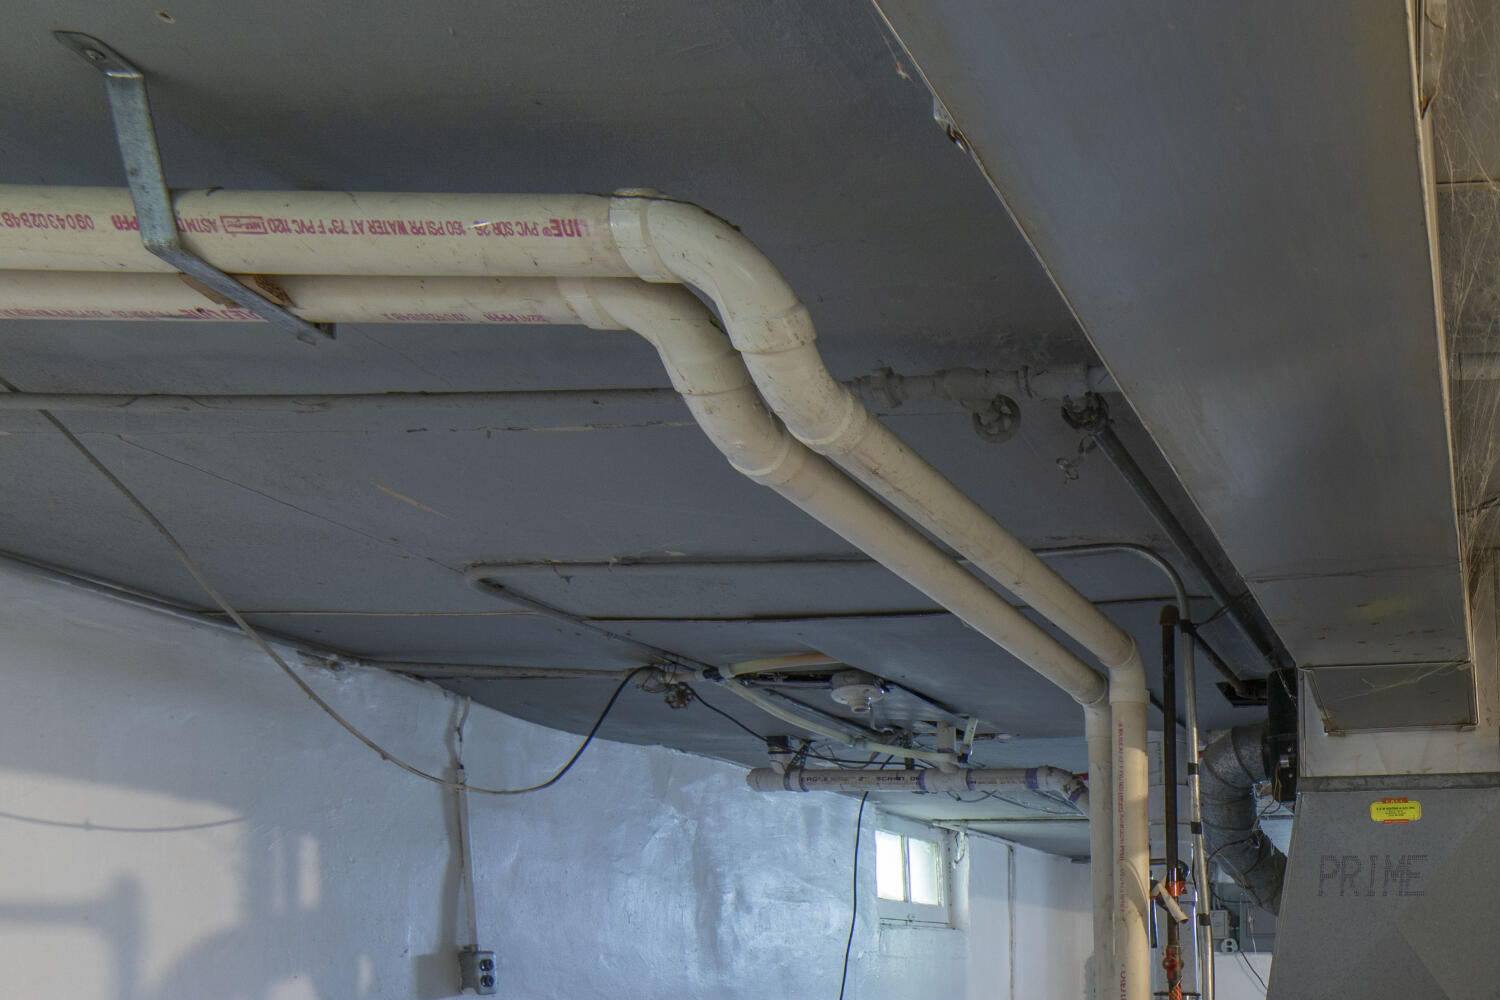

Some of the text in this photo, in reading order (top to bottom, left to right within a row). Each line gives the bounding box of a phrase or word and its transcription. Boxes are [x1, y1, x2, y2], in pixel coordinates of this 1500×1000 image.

[349, 219, 365, 235] AT
[367, 219, 409, 236] WATER
[1317, 854, 1429, 897] PRIME
